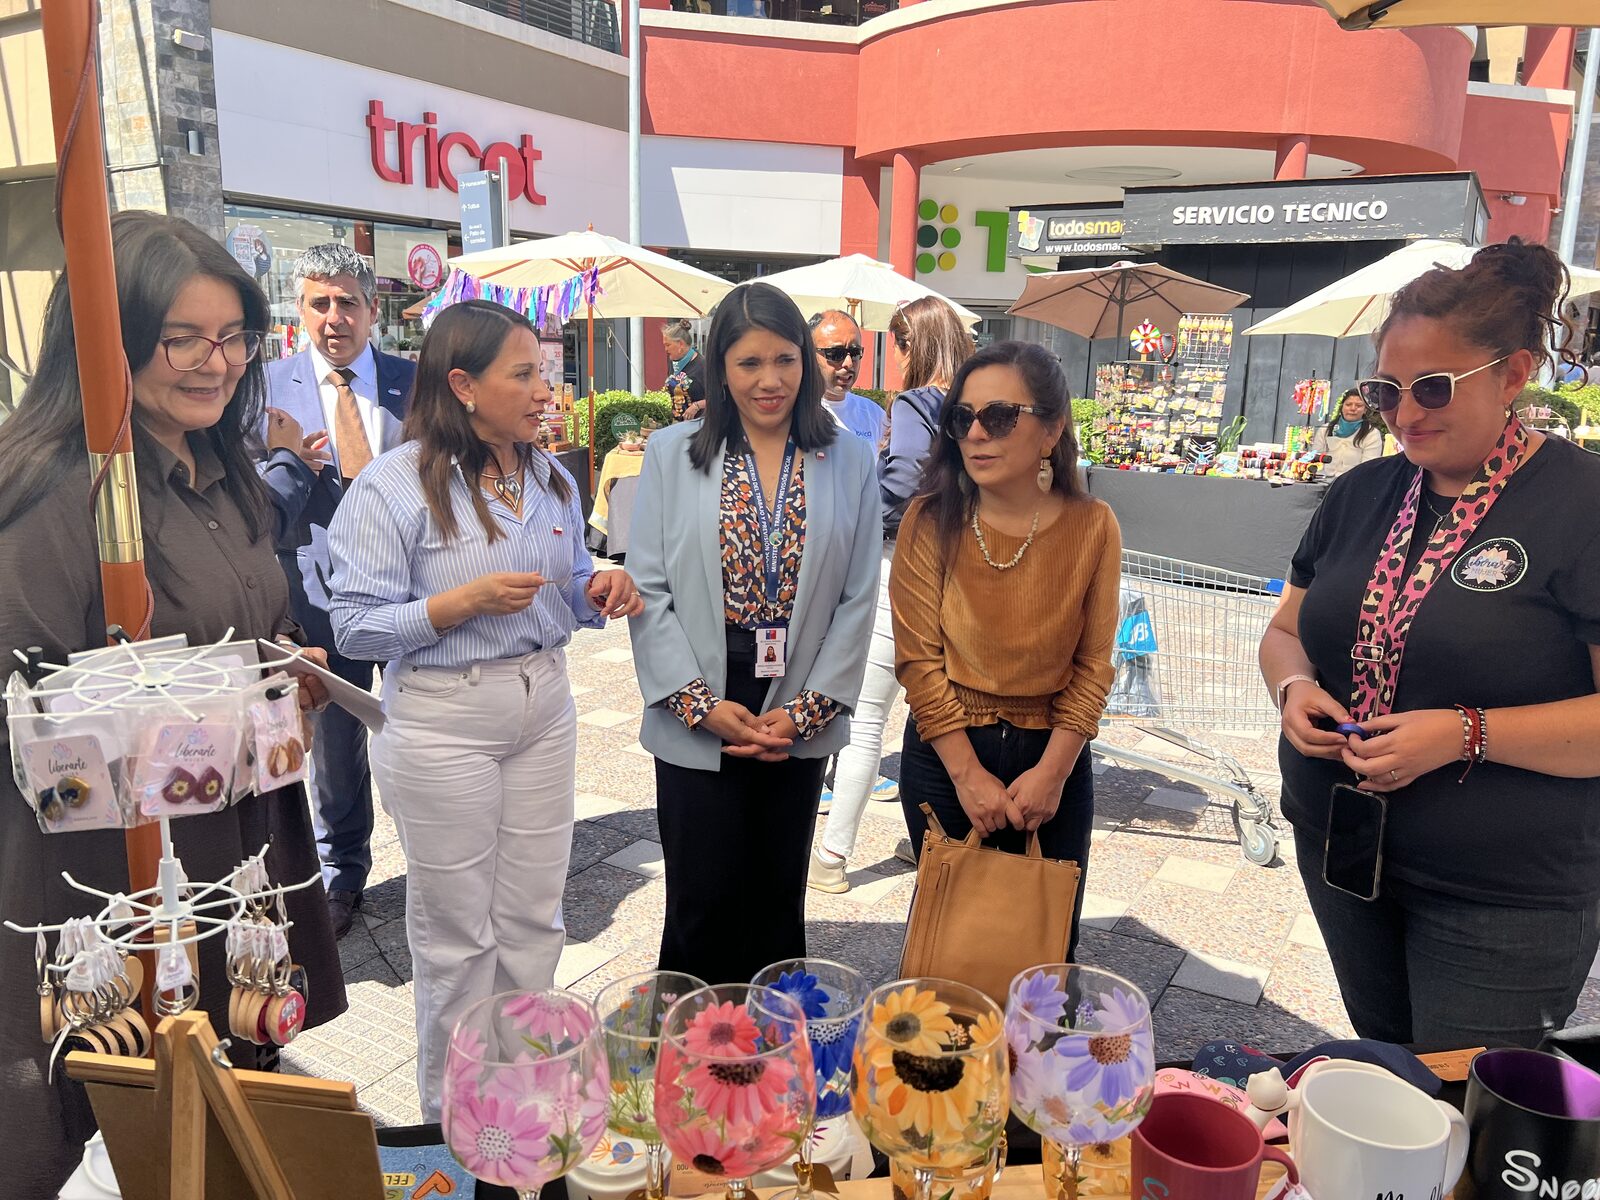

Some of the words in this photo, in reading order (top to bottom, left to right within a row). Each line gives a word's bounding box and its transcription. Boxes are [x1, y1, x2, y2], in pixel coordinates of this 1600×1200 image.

[366, 99, 547, 206] tricot
[1172, 204, 1275, 225] SERVICIO
[1282, 199, 1389, 224] TECNICO
[745, 454, 757, 481] MINISTERIO
[755, 491, 765, 516] TRABAJO
[774, 505, 783, 528] TRABAJO
[784, 455, 792, 474] SOCIAL
[281, 997, 298, 1018] CREE
[286, 1009, 298, 1028] EN
[383, 1175, 409, 1187] FEL
